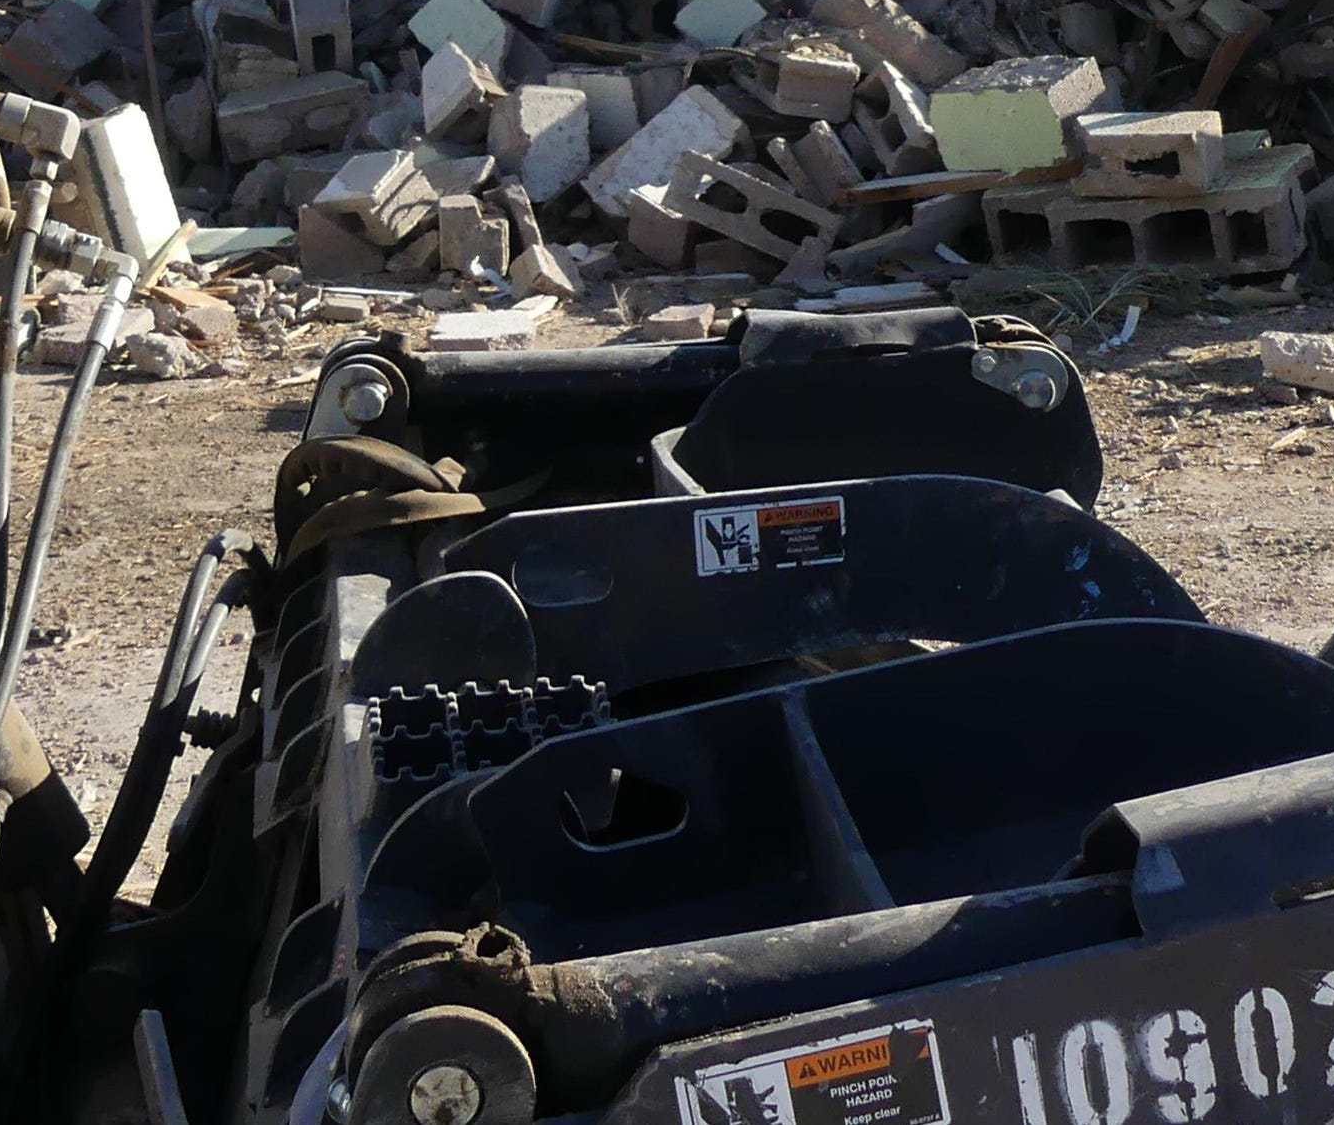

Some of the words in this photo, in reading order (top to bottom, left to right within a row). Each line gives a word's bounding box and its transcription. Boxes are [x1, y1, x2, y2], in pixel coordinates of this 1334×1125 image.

[776, 506, 833, 519] WARNING
[819, 1044, 887, 1074] WARNI
[829, 1082, 867, 1098] PINCH
[868, 1074, 898, 1092] POIN
[845, 1088, 894, 1108] HAZARD
[844, 1110, 874, 1125] Keep
[874, 1105, 902, 1119] clear
